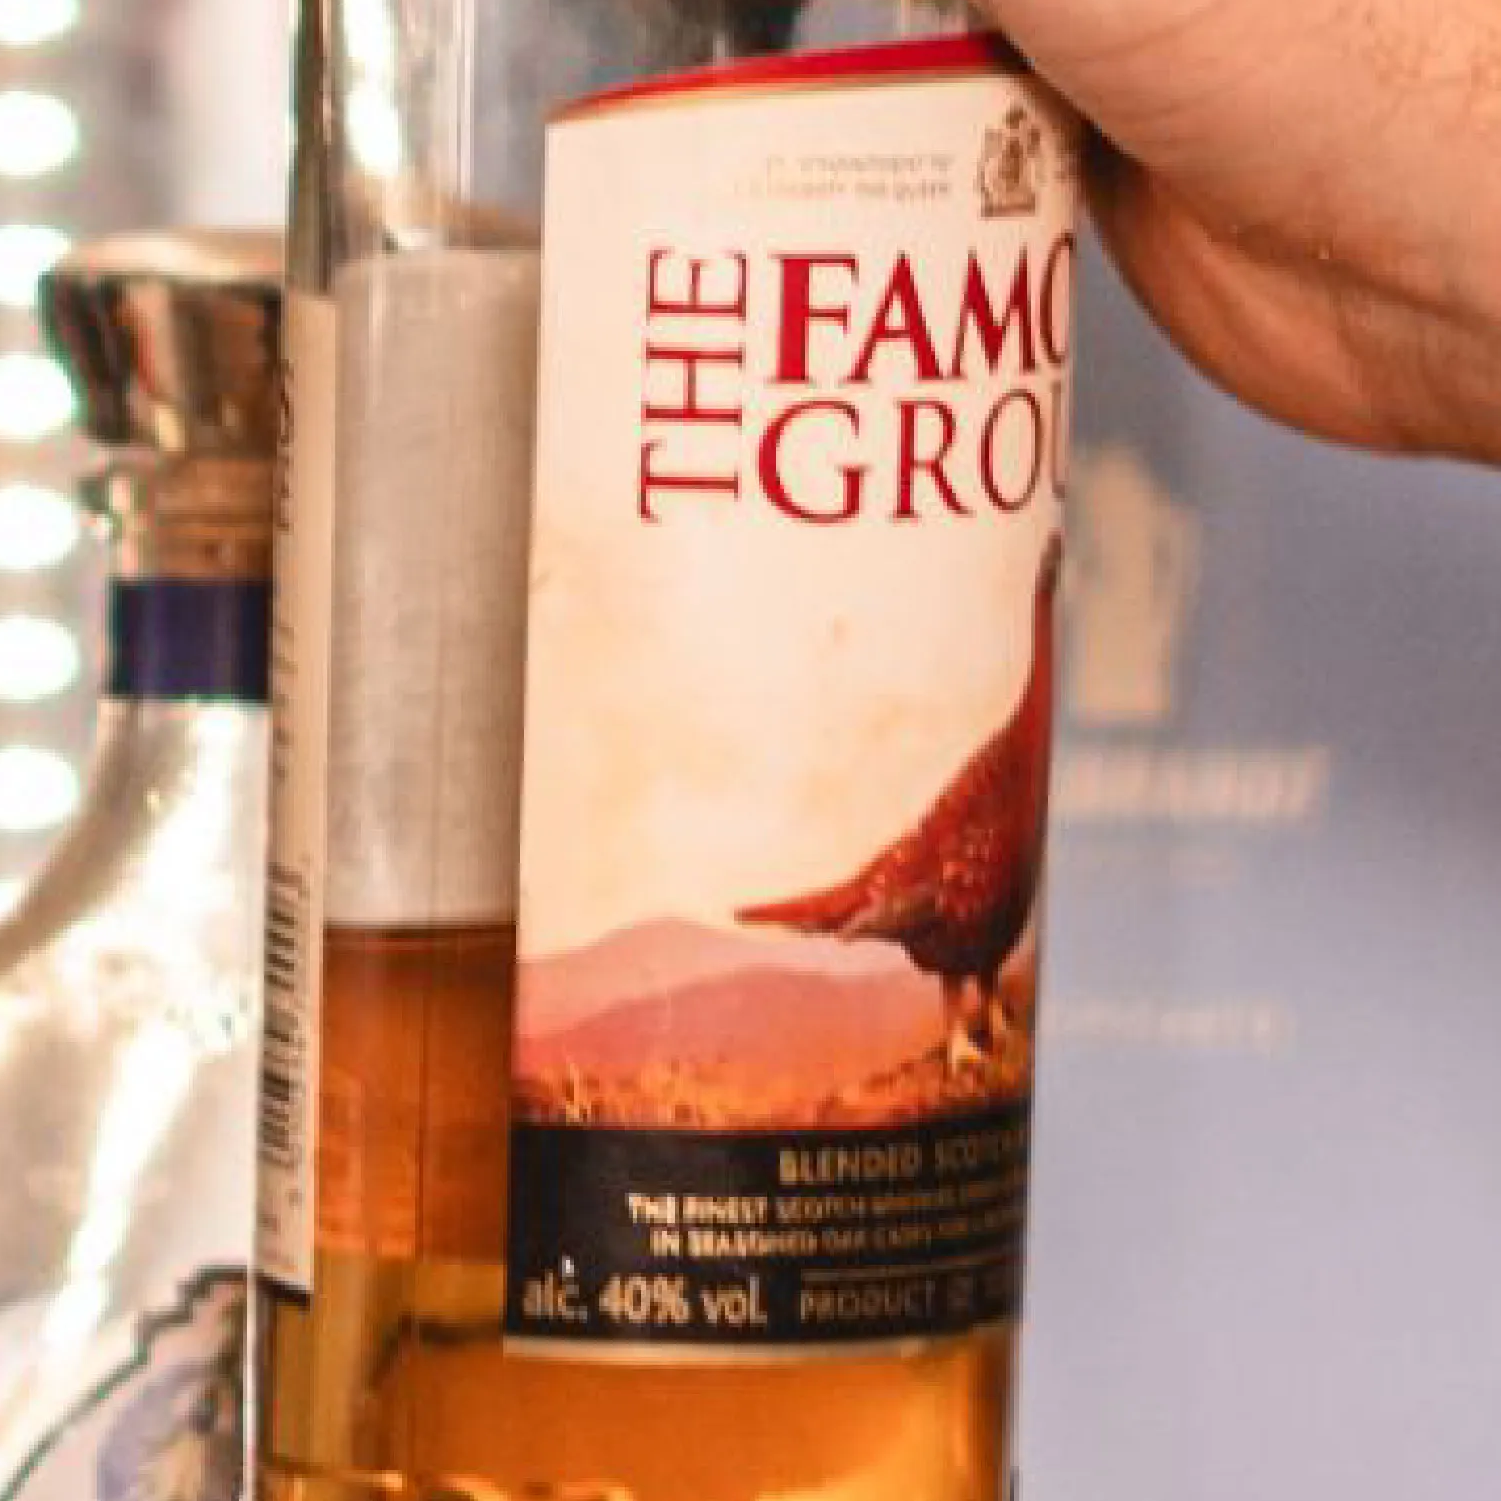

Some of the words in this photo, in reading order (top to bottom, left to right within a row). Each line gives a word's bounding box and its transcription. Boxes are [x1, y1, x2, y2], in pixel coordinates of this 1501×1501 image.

[637, 244, 747, 523] THE
[779, 1140, 922, 1186] BLENDED
[628, 1191, 677, 1225] THE
[683, 1193, 768, 1225] FINEST
[775, 1191, 866, 1222] SCOTCH
[650, 1231, 681, 1257] IN
[599, 1272, 692, 1324] 40%
[799, 1280, 937, 1324] PRODUCT
